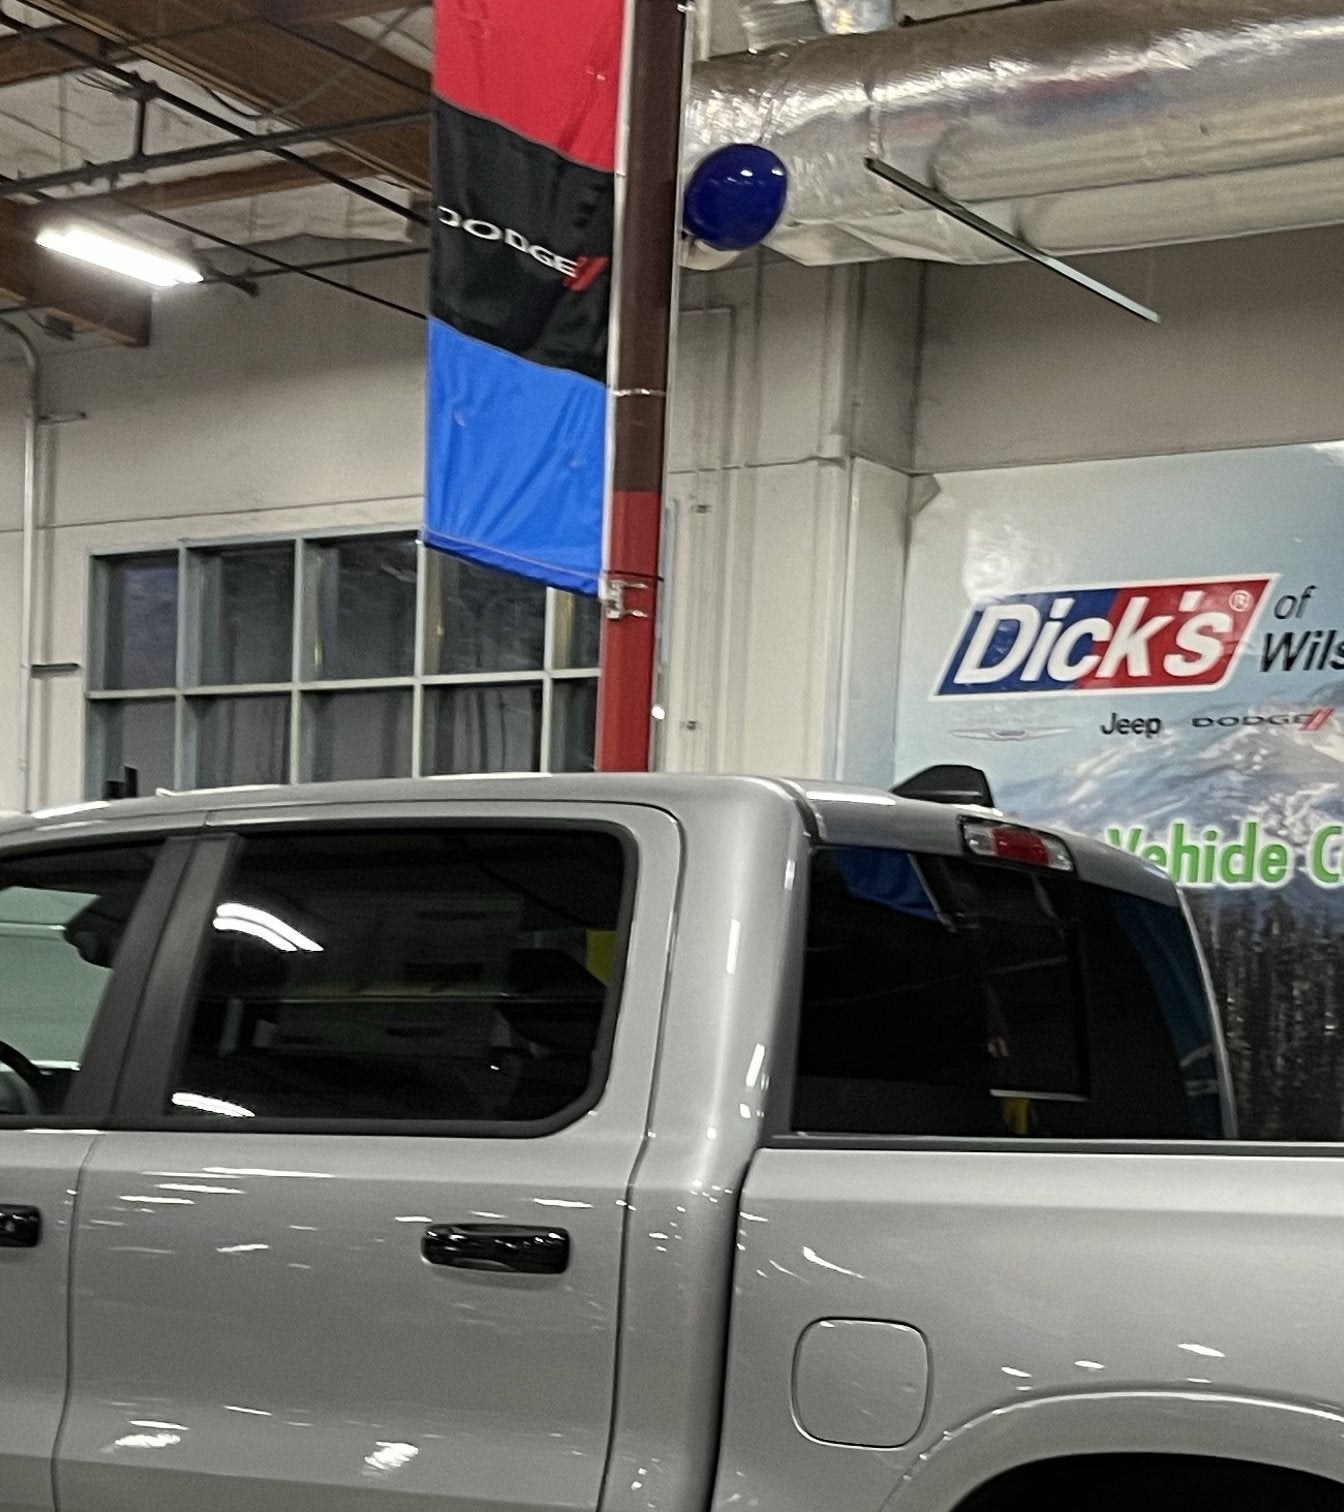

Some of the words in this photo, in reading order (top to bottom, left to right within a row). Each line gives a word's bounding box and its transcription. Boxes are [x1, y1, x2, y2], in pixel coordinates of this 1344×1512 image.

[437, 205, 579, 278] DODGE
[1273, 584, 1319, 620] of
[1100, 712, 1163, 739] Jeep
[1191, 712, 1314, 729] DODGE
